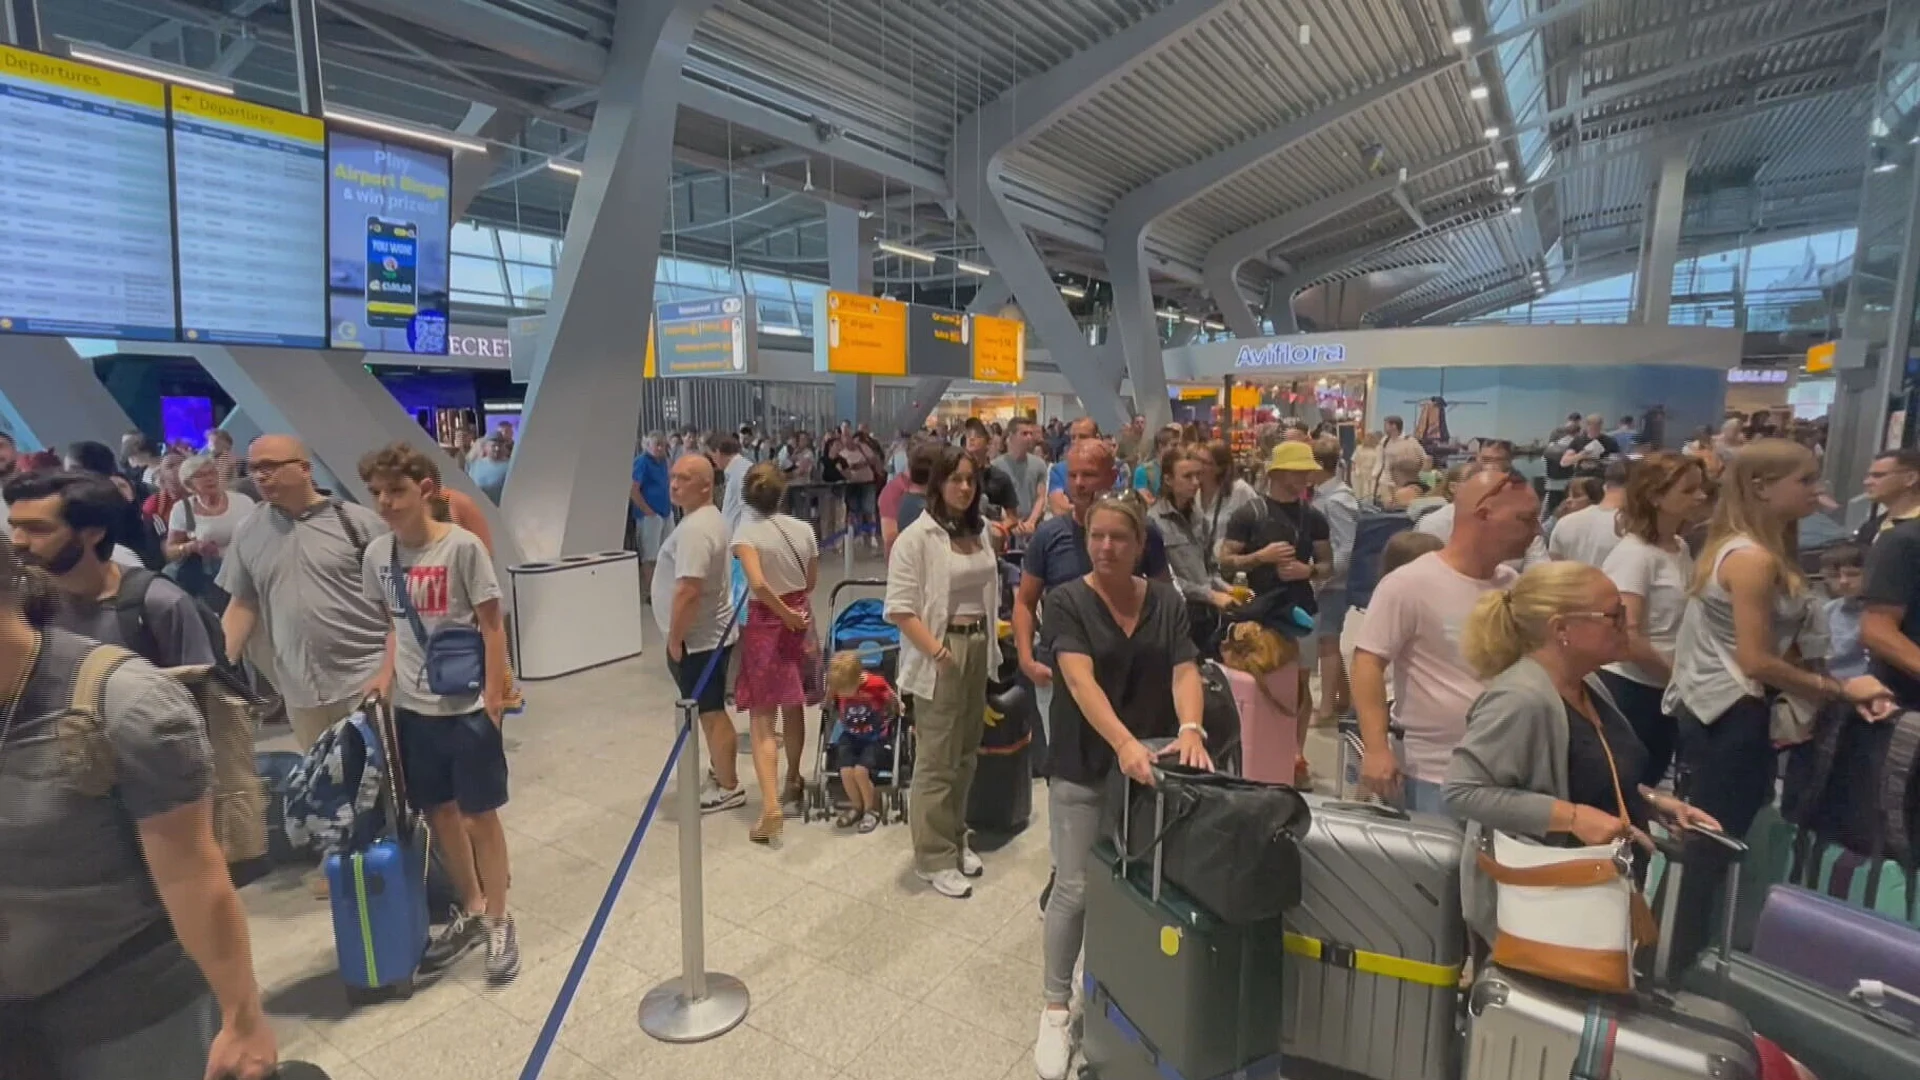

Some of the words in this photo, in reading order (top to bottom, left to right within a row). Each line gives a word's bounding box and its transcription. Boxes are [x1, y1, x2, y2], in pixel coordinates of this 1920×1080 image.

[4, 52, 102, 88] Departures
[199, 98, 276, 127] Departures
[335, 162, 396, 189] Airport
[374, 149, 411, 177] Play
[355, 188, 385, 206] win
[1235, 343, 1346, 367] Aviflora
